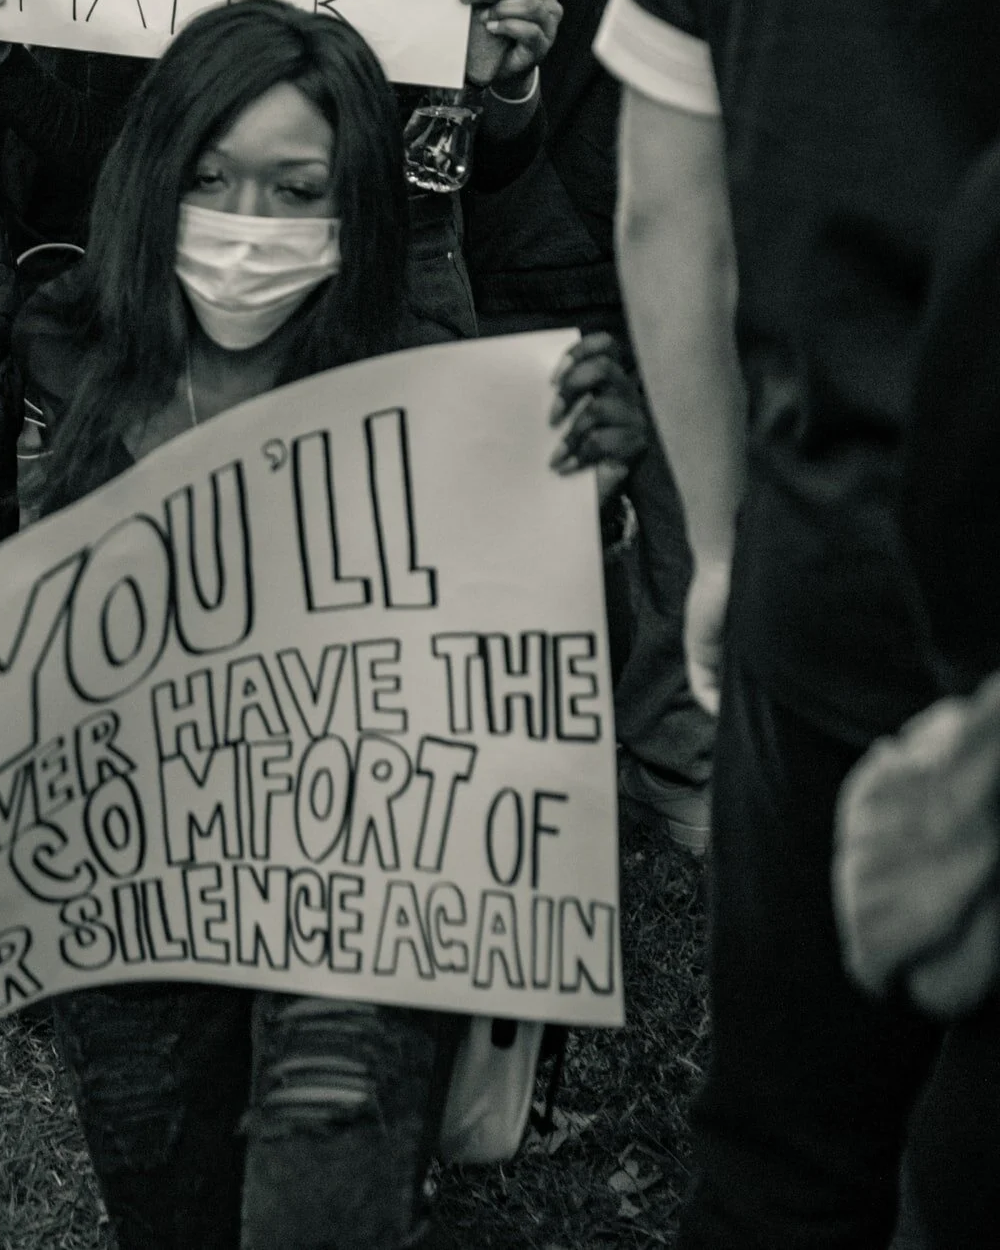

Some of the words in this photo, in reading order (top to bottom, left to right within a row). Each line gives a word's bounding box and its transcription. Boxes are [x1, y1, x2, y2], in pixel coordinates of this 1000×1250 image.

[151, 638, 409, 758] HAVE
[431, 630, 602, 743] THE
[8, 733, 478, 904] COMFORT
[485, 786, 569, 889] OF
[60, 862, 365, 973] SILENCE
[373, 880, 616, 996] AGAIN
